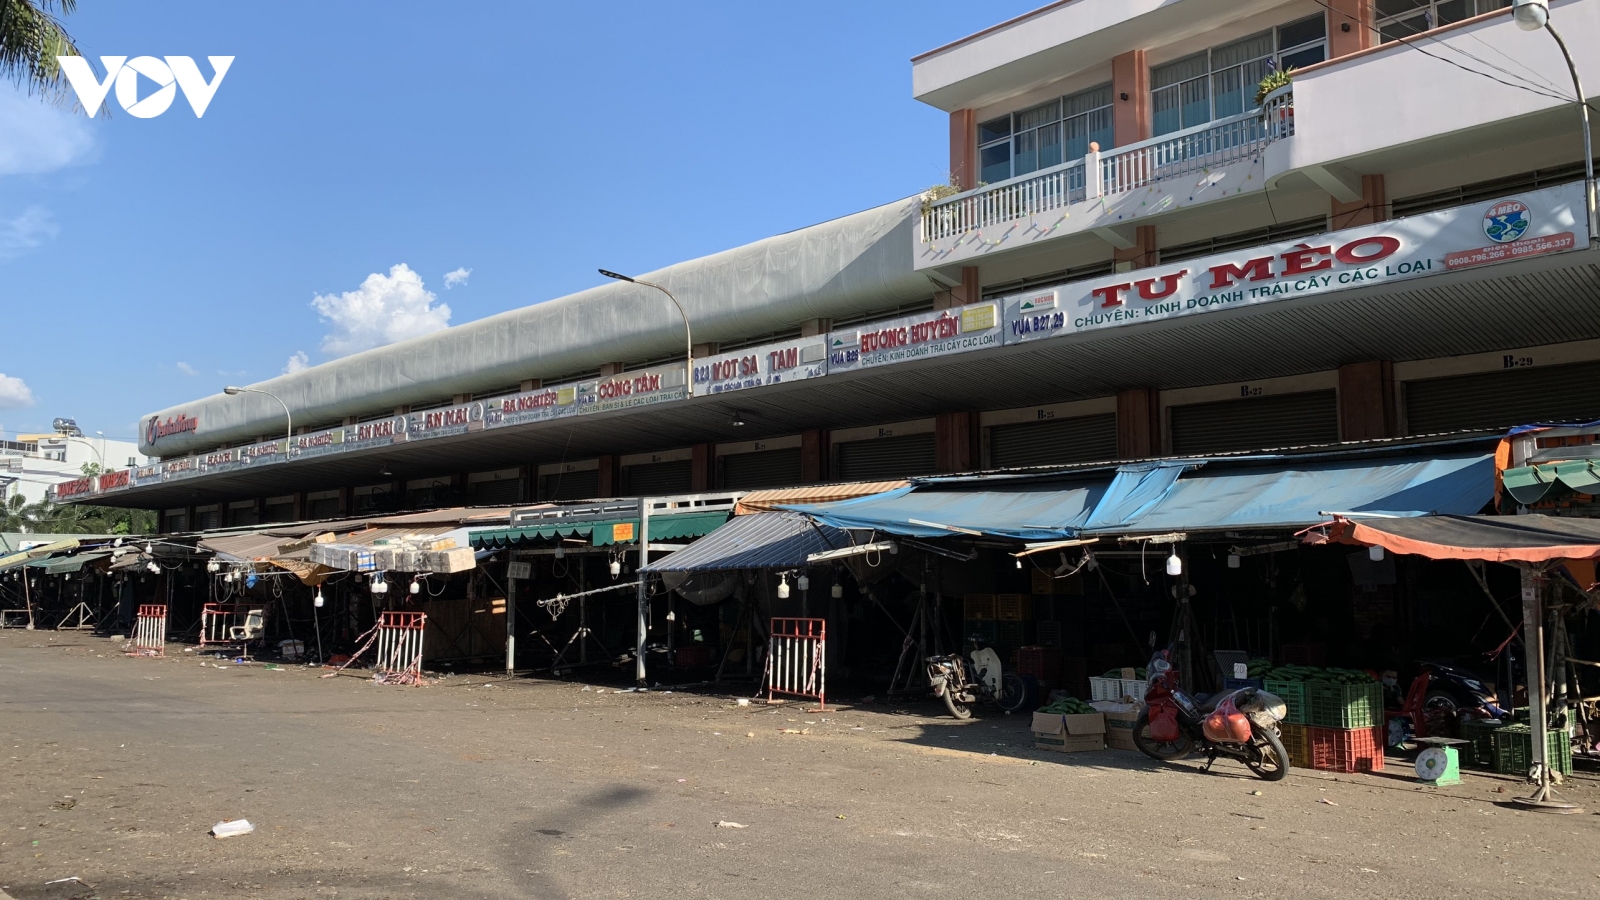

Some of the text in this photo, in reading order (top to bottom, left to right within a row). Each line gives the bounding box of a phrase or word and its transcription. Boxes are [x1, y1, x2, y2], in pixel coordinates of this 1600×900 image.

[1498, 203, 1520, 215] MÈO
[1449, 249, 1505, 266] 0908.796.266
[1512, 238, 1571, 255] 0985.566.337
[1092, 236, 1400, 308] TƯ MÈO
[1074, 258, 1432, 328] CHUYÊN: KINH DOANH TRÁI CÂY CÁC LOẠI
[890, 350, 905, 361] KINH
[906, 347, 928, 358] DOANH
[930, 343, 946, 353] TRÁI
[947, 340, 960, 351] CÂY
[962, 337, 977, 348] CÁC
[979, 334, 996, 347] LOẠI
[600, 372, 660, 399] CÔNG TÂM
[503, 399, 516, 413] BA
[426, 411, 442, 429] AN
